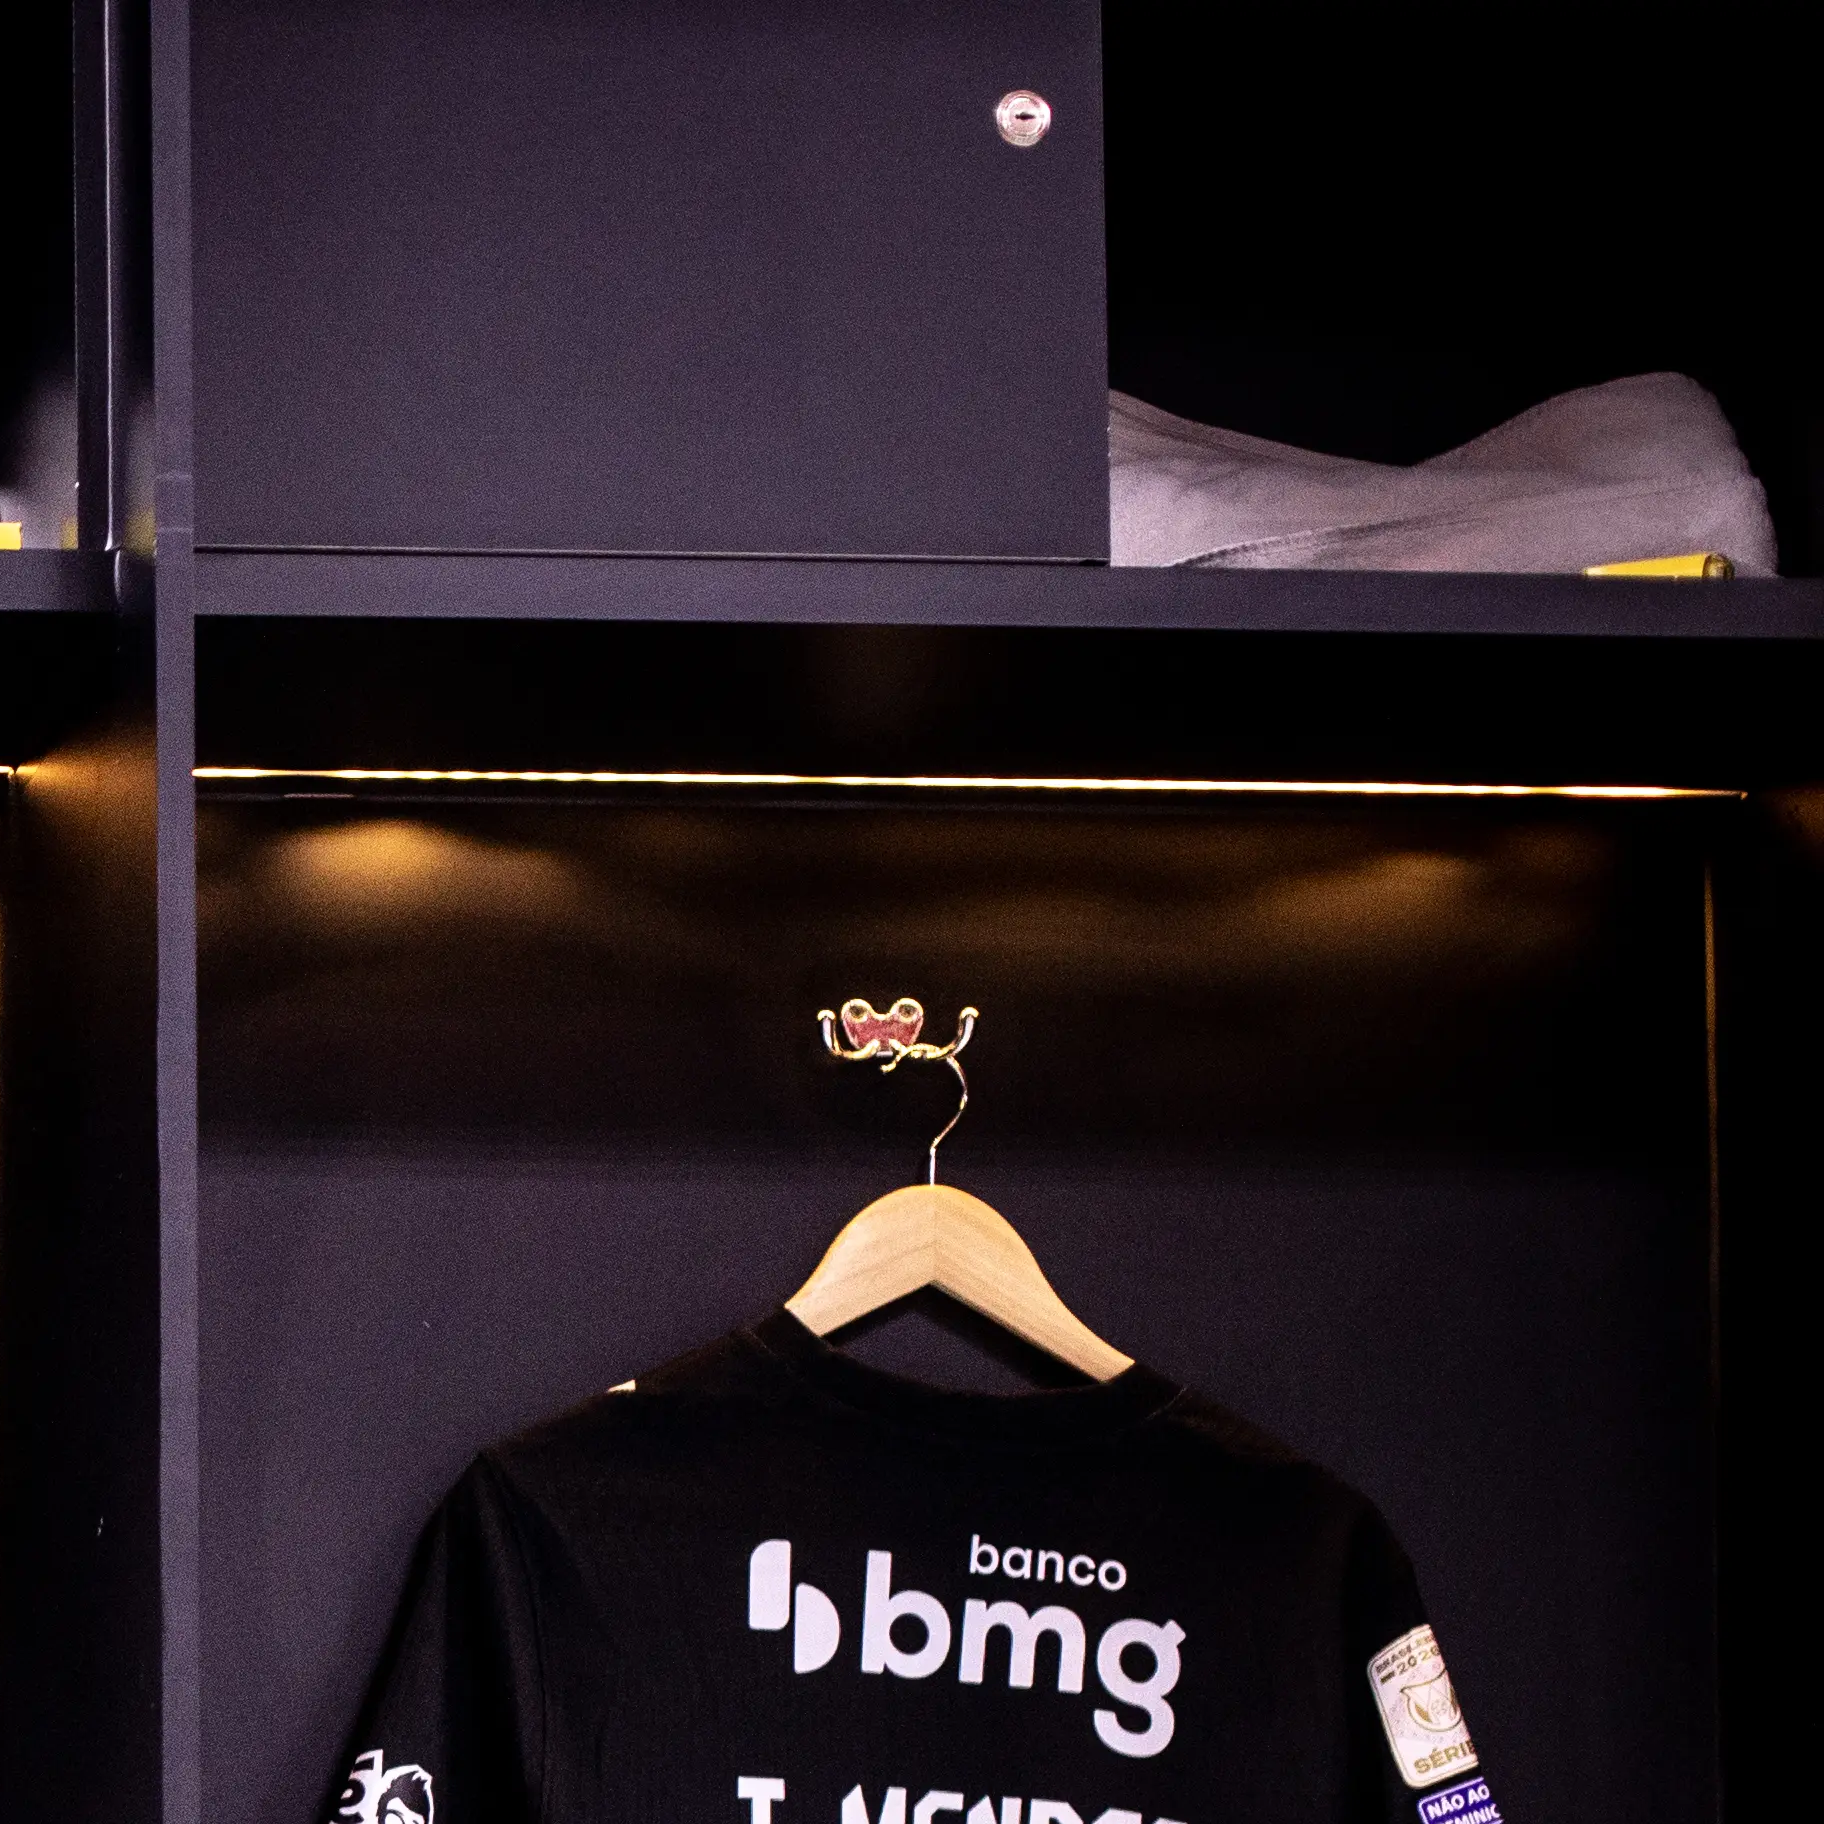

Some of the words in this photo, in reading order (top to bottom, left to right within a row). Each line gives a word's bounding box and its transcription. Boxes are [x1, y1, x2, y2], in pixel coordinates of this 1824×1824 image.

[969, 1534, 1127, 1591] banco
[862, 1550, 1187, 1758] bmg
[1426, 1794, 1466, 1820] NÃO
[1467, 1784, 1491, 1805] AO
